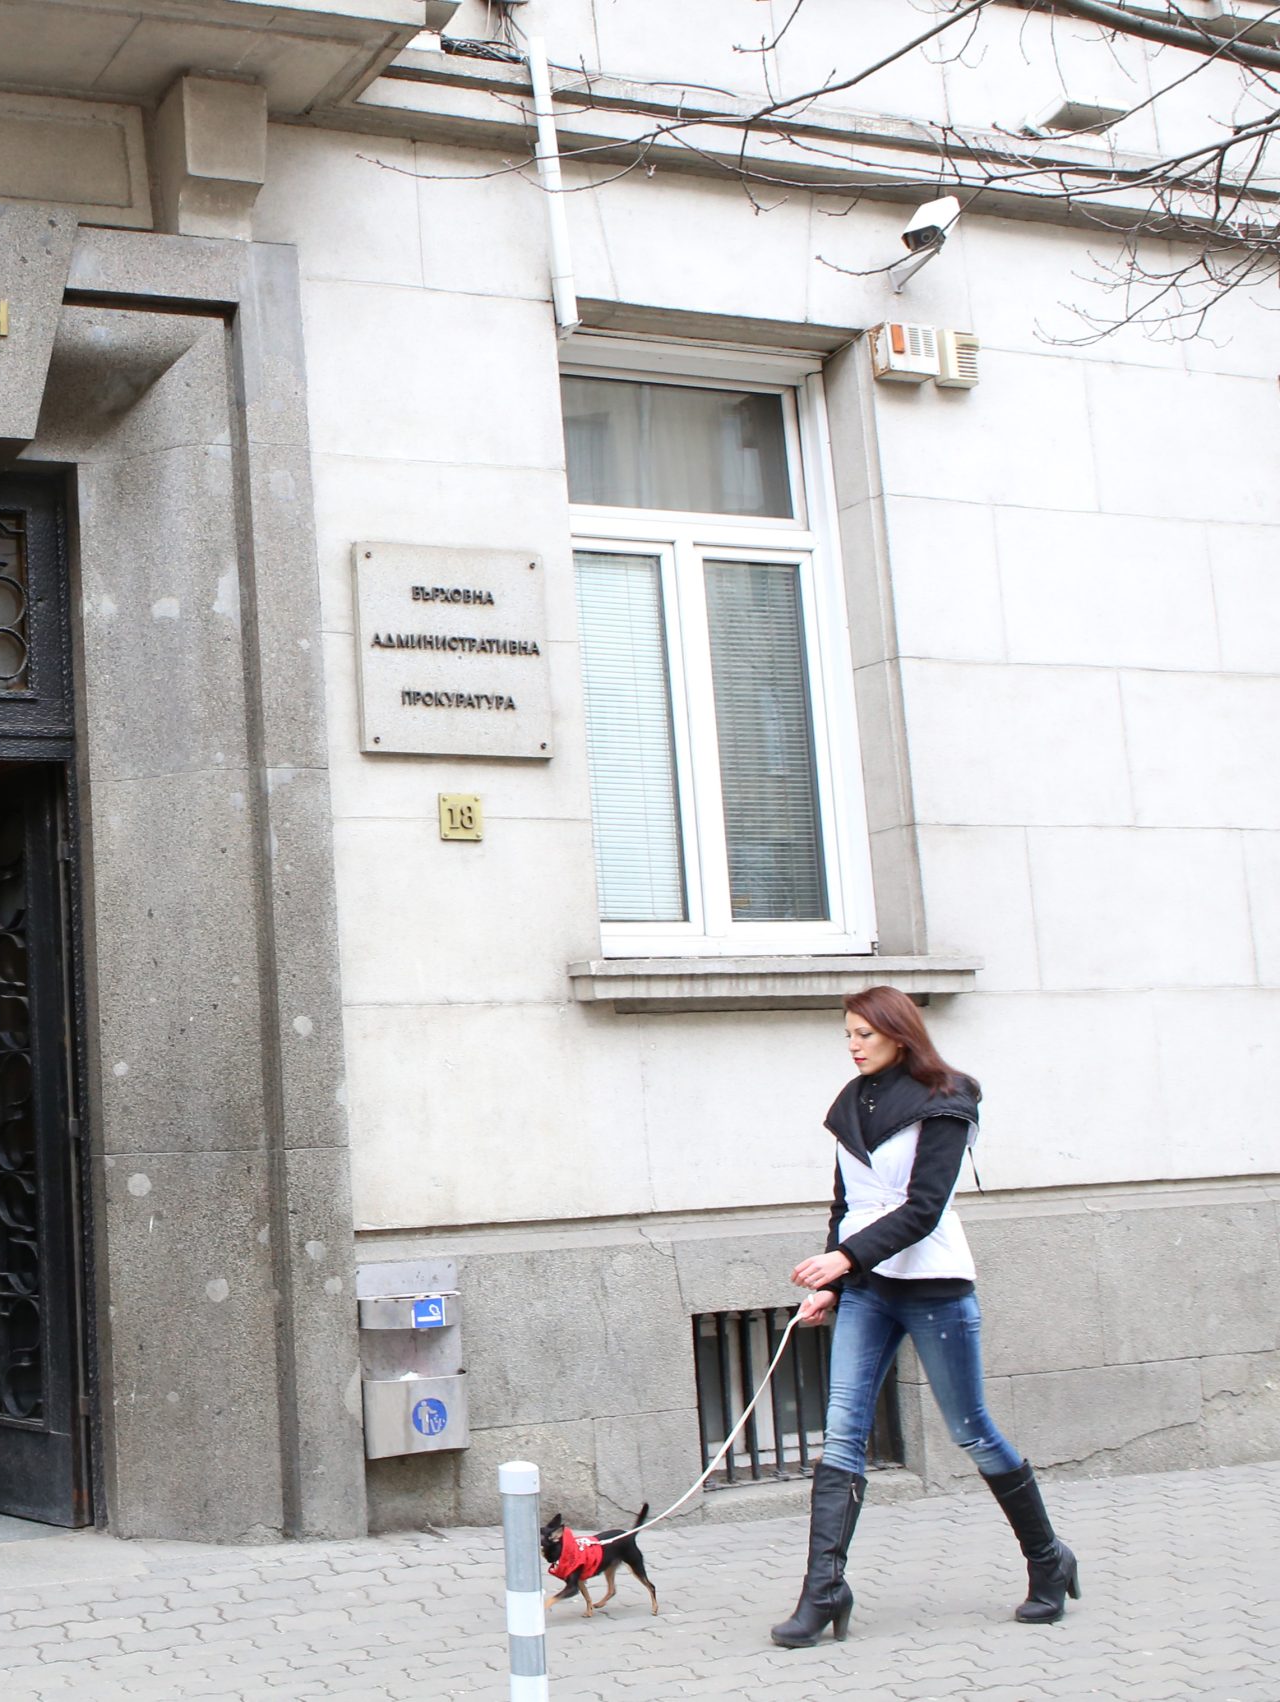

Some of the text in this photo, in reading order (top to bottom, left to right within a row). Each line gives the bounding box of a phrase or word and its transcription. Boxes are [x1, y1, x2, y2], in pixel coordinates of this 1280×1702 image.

[411, 585, 494, 606] ВЪРХОВНА
[371, 632, 541, 656] АДМИНИСТРАТИВНА
[401, 689, 516, 711] ПРОКУРАТУРА
[447, 804, 477, 830] 18
